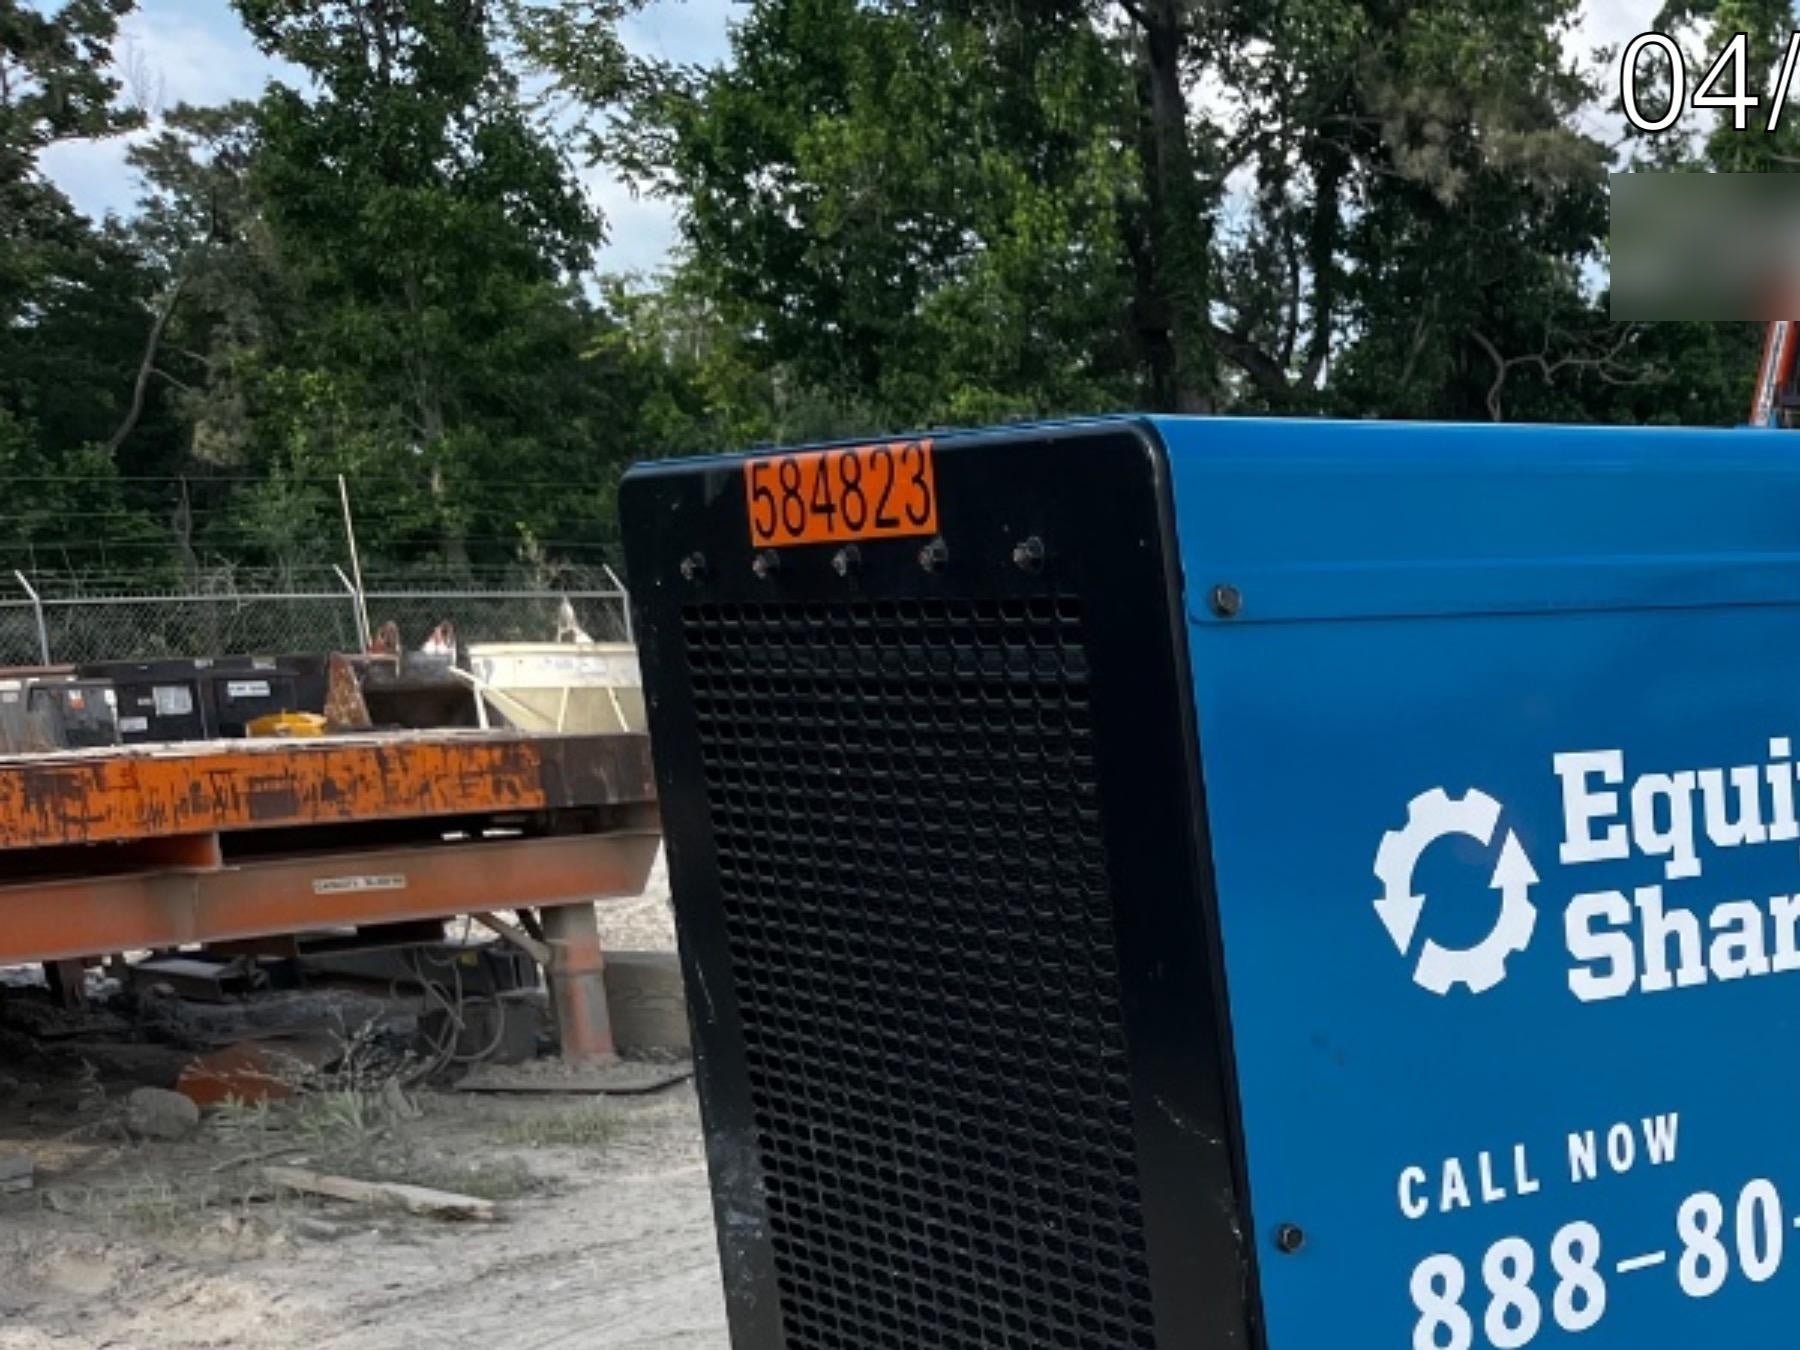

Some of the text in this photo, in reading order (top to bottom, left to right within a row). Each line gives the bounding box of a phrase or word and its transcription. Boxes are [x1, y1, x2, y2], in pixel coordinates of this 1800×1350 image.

[752, 444, 931, 539] 584823
[1398, 1112, 1679, 1219] CALL NOW
